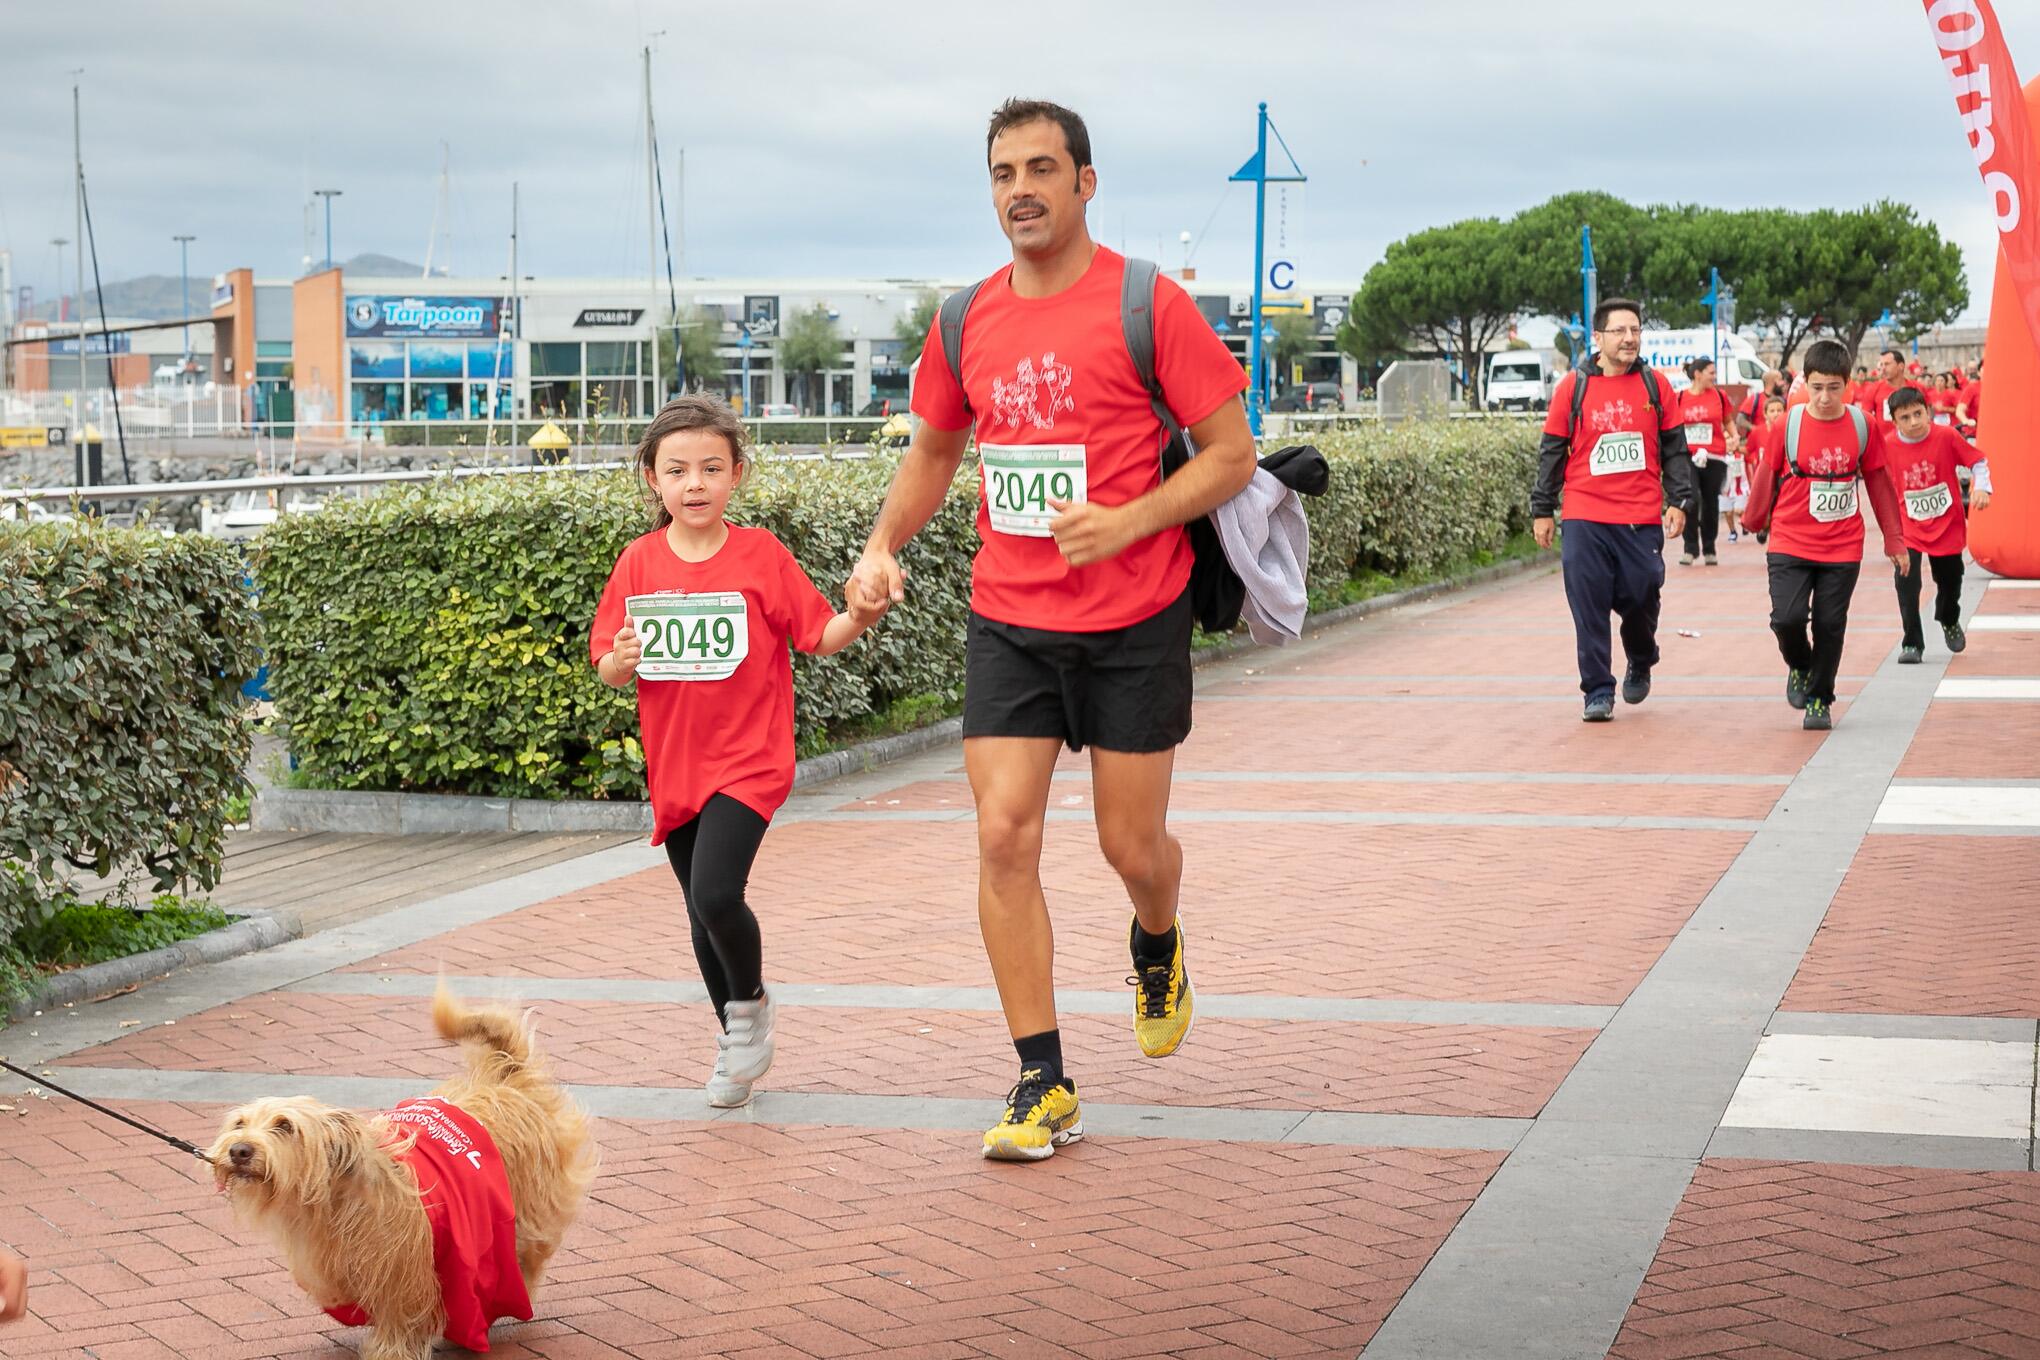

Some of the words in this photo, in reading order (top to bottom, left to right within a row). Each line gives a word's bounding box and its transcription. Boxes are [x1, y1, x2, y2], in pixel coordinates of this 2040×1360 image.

[1270, 261, 1294, 290] C
[384, 303, 483, 329] Tarpoon
[1597, 442, 1639, 464] 2006
[993, 471, 1073, 512] 2049
[1911, 492, 1948, 513] 2006
[641, 617, 734, 659] 2049
